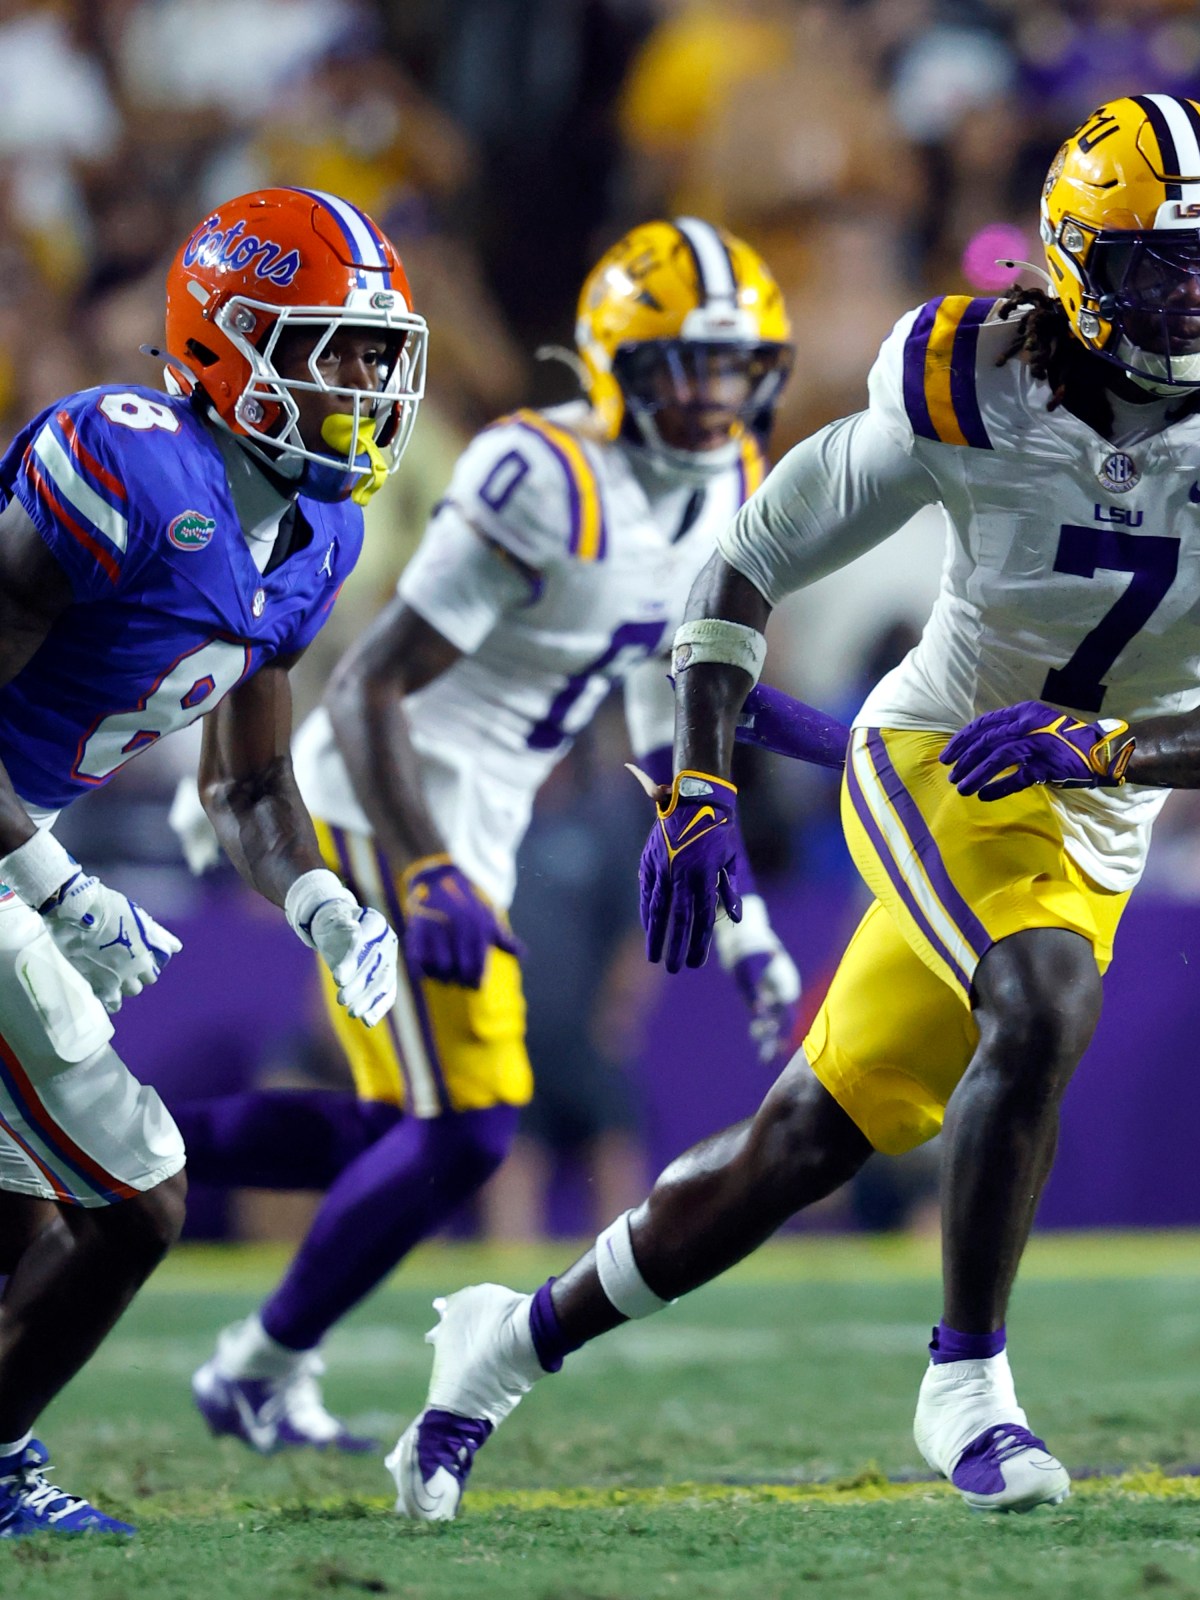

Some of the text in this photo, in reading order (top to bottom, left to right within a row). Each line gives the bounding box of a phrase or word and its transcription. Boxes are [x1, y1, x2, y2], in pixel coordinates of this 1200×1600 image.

[183, 216, 300, 287] Gators
[96, 392, 182, 434] 8
[1106, 454, 1133, 482] SEC
[1094, 503, 1144, 527] LSU
[1040, 524, 1181, 713] 7
[70, 630, 252, 785] 8
